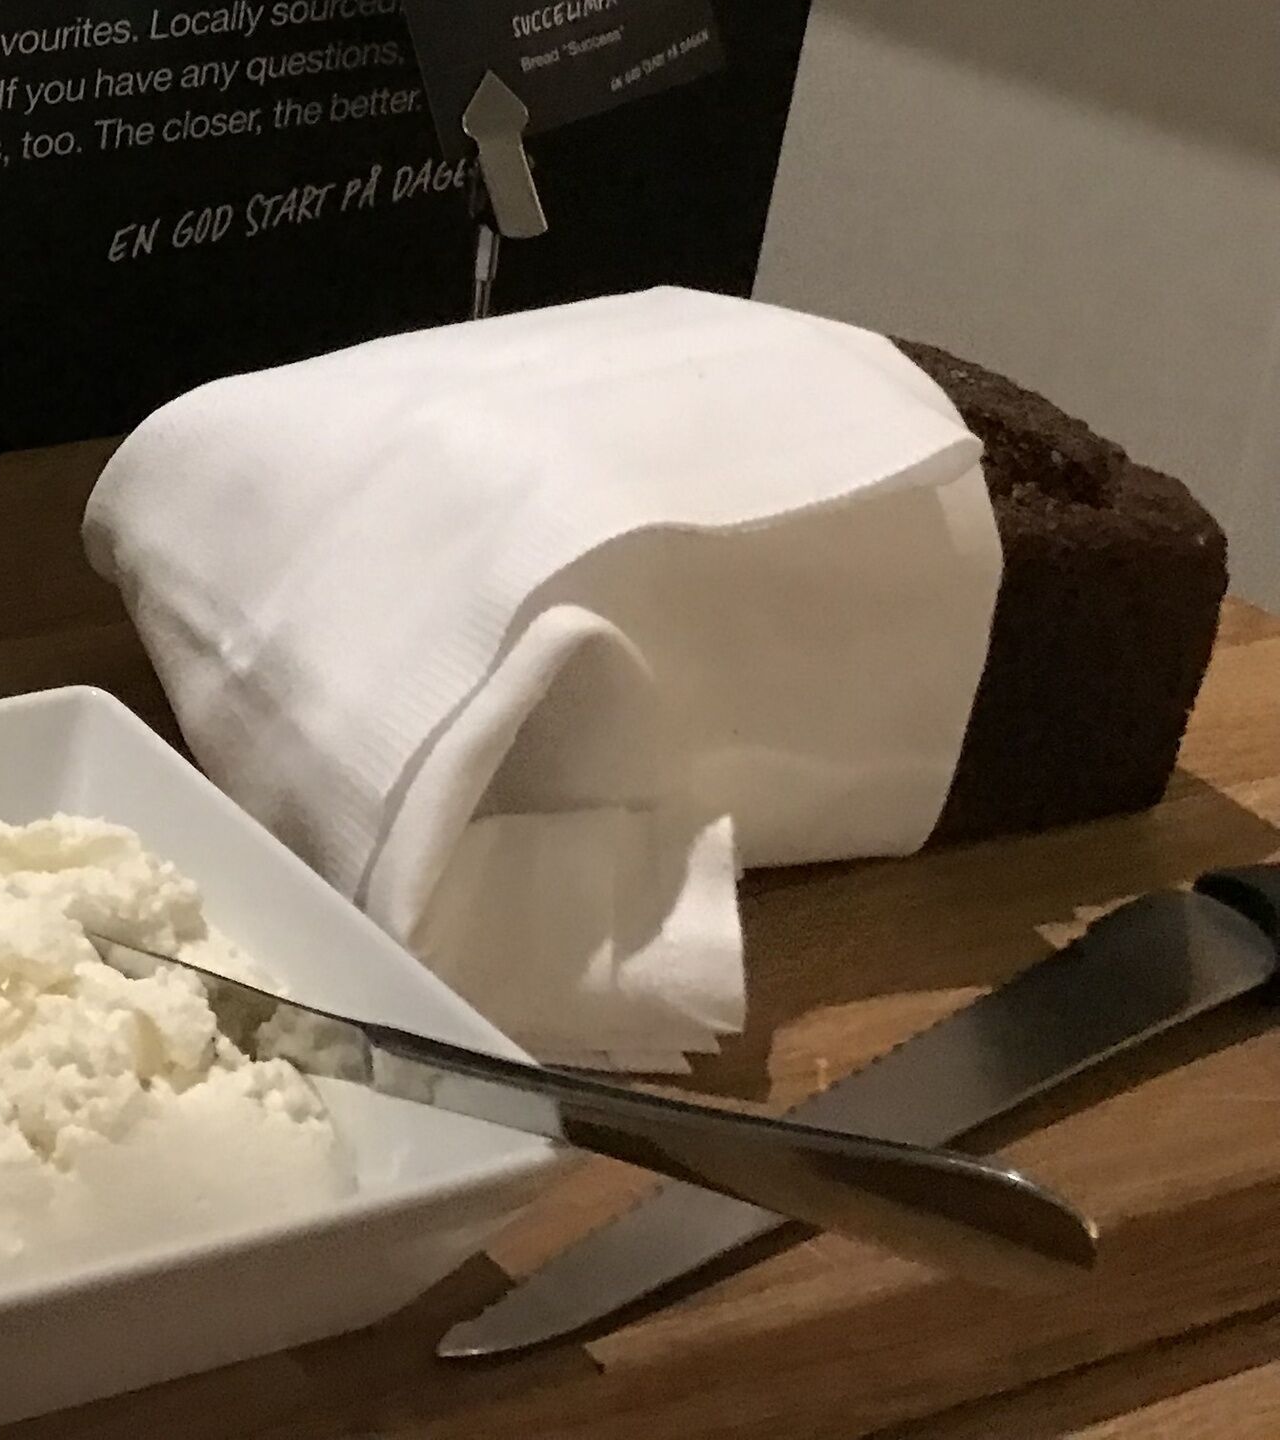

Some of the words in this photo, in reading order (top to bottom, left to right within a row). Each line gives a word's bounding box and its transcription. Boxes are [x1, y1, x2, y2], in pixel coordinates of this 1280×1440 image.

[150, 0, 264, 39] Locally
[24, 79, 85, 114] you
[95, 66, 173, 99] have
[180, 58, 240, 93] any
[22, 132, 82, 158] too.
[94, 116, 154, 150] The
[161, 107, 264, 143] closer,
[273, 97, 322, 129] the
[329, 85, 423, 122] better.
[108, 220, 160, 262] EN
[172, 205, 233, 248] GOD
[245, 183, 336, 237] START
[341, 165, 378, 212] PÅ
[393, 159, 467, 203] DAGE
